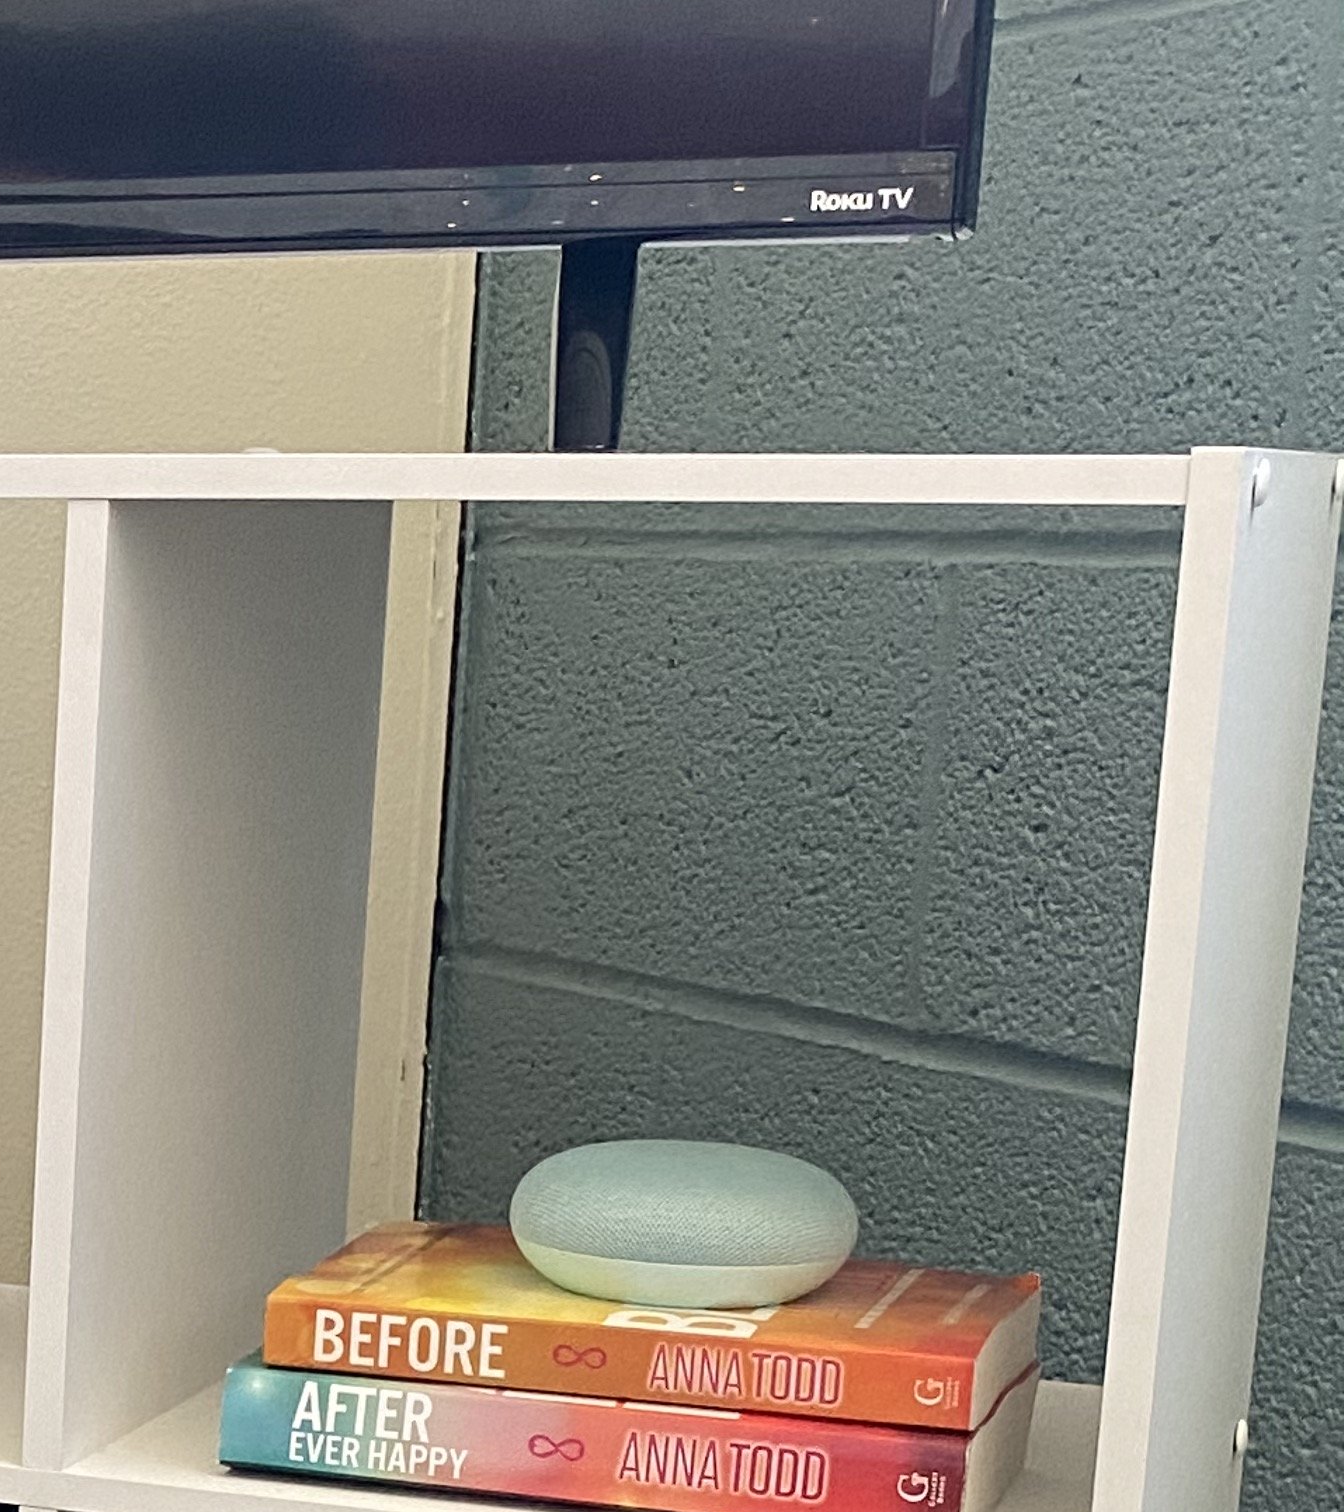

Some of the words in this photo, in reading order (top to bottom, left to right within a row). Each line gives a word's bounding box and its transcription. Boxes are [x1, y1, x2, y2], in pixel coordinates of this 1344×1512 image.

[877, 187, 914, 210] TV
[313, 1308, 509, 1379] BEFORE
[648, 1342, 743, 1397] ANNA
[751, 1351, 842, 1405] TODD
[913, 1378, 944, 1406] G
[291, 1380, 433, 1443] AFTER
[288, 1431, 360, 1468] EVER
[367, 1439, 469, 1480] HAPPY
[618, 1431, 720, 1490] ANNA
[728, 1441, 827, 1501] TODD
[896, 1471, 929, 1503] G
